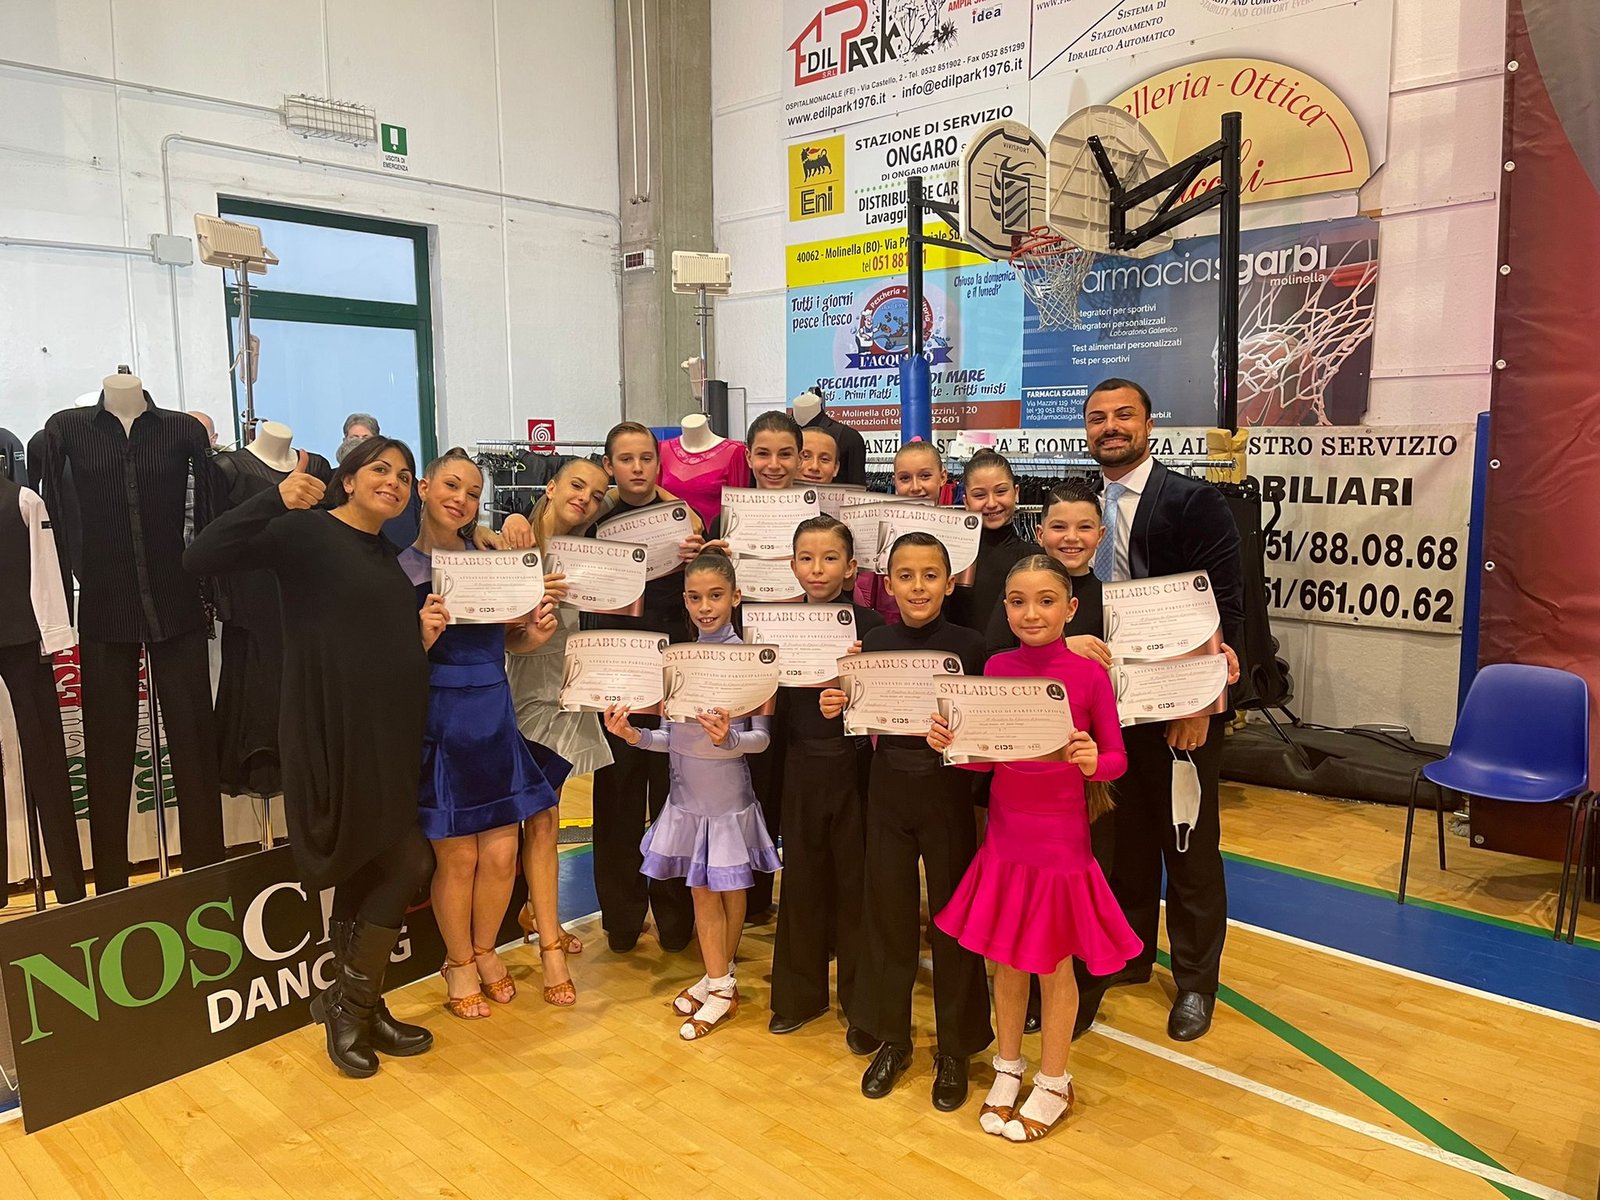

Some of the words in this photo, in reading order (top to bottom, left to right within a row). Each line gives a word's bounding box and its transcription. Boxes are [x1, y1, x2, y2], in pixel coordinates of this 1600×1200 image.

[972, 7, 1002, 24] idea
[1117, 3, 1154, 20] SISTEMA
[1090, 16, 1164, 42] STAZIONAMENTO
[1067, 45, 1114, 63] IDRAULICO
[1116, 28, 1176, 51] AUTOMATICO
[785, 90, 842, 111] OSPITALMONACALE
[844, 87, 856, 97] (FE)
[861, 82, 870, 91] Via
[921, 65, 936, 76] 0532
[938, 59, 961, 72] 851902
[967, 55, 979, 64] Fax
[981, 49, 998, 60] 0532
[1000, 42, 1025, 56] 851299
[787, 92, 886, 126] www.edilpark1976.it
[902, 57, 1023, 99] info@edilpark1976.it
[1230, 67, 1326, 128] Ottica
[855, 126, 921, 151] STAZIONE
[924, 123, 939, 135] DI
[943, 105, 1014, 132] SERVIZIO
[886, 135, 958, 168] ONGARO
[881, 172, 890, 182] DI
[892, 165, 929, 180] ONGARO
[801, 185, 833, 216] Eni
[866, 204, 907, 226] Lavaggi
[796, 249, 819, 263] 40062
[825, 242, 861, 259] Molinella
[885, 238, 898, 250] Via
[862, 261, 871, 273] tel
[873, 254, 889, 271] 051
[953, 275, 975, 288] Chiuso
[975, 273, 982, 284] la
[983, 270, 1016, 284] domenica
[1270, 271, 1326, 287] molinella
[791, 296, 813, 312] Tutti
[822, 291, 854, 312] giorni
[870, 287, 901, 309] Pescheria
[1113, 306, 1127, 316] per
[1128, 303, 1157, 315] sportivi
[792, 316, 819, 333] pesce
[822, 311, 853, 327] fresco
[1112, 316, 1166, 329] personalizzati
[1110, 328, 1147, 338] Laboratorio
[1148, 326, 1178, 335] Galenico
[1072, 344, 1087, 352] Test
[1088, 341, 1127, 351] alimentari
[1127, 338, 1183, 350] personalizzati
[1072, 357, 1087, 365] Test
[1088, 357, 1101, 366] per
[1102, 354, 1130, 366] sportivi
[945, 368, 986, 384] MARE
[845, 390, 866, 400] Primi
[869, 388, 892, 400] Piatti
[953, 384, 978, 397] Fritti
[981, 382, 1007, 395] misti
[1026, 390, 1061, 398] FARMACIA
[1061, 389, 1088, 397] SGARBI
[842, 409, 879, 417] Molinella
[881, 408, 900, 418] (BO)
[961, 405, 978, 414] 120
[1036, 399, 1058, 407] Mazzini
[1018, 437, 1029, 451] E
[1249, 436, 1313, 456] STRO
[1321, 435, 1458, 456] SERVIZIO
[724, 493, 776, 504] SYLLABUS
[778, 494, 801, 504] CUP
[599, 519, 646, 539] SYLLABUS
[648, 512, 670, 525] CUP
[883, 509, 936, 522] SYLLABUS
[938, 514, 962, 525] CUP
[551, 541, 604, 555] SYLLABUS
[606, 548, 630, 558] CUP
[1266, 529, 1459, 571] 51/88.08.68
[434, 554, 492, 566] SYLLABUS
[495, 556, 519, 566] CUP
[1104, 585, 1160, 600] SYLLABUS
[1163, 581, 1190, 594] CUP
[746, 612, 805, 622] SYLLABUS
[808, 612, 834, 622] CUP
[568, 638, 626, 650] SYLLABUS
[630, 639, 655, 649] CUP
[665, 650, 726, 661] SYLLABUS
[729, 651, 755, 662] CUP
[842, 659, 908, 671] SYLLABUS
[911, 659, 939, 669] CUP
[940, 683, 1007, 697] SYLLABUS
[1011, 685, 1041, 696] CUP
